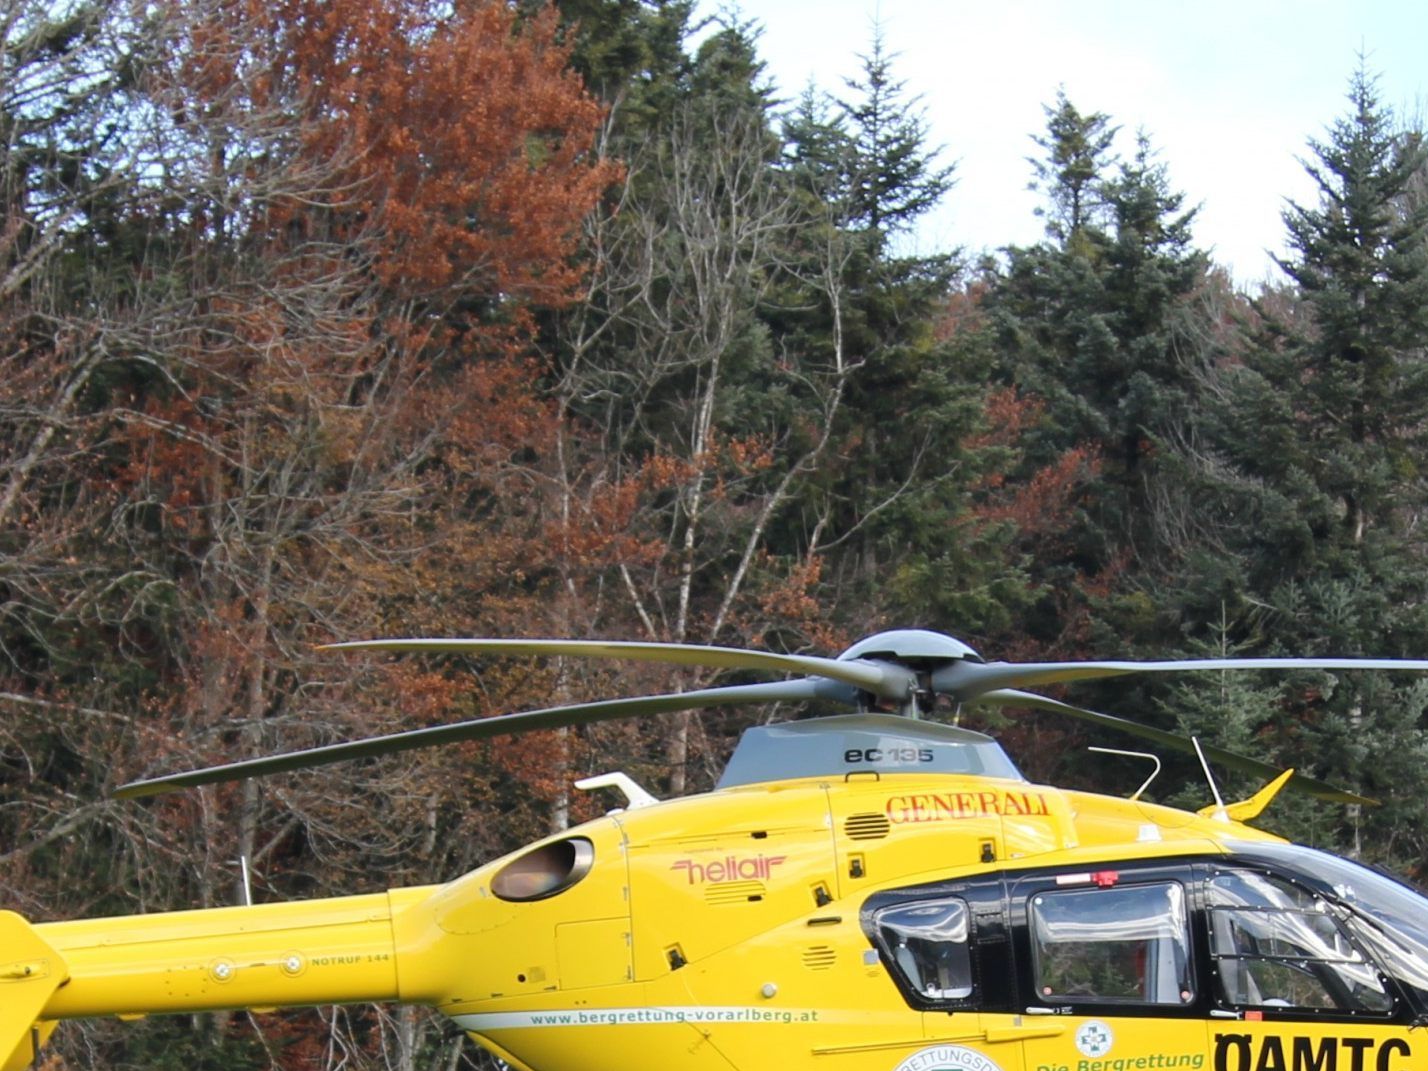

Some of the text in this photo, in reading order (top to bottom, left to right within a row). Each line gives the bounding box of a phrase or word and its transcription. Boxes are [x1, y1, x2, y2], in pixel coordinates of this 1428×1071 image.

[886, 792, 1051, 824] GENERALI
[670, 854, 788, 885] heliair
[311, 954, 389, 967] NOTRUF 144
[531, 1009, 819, 1025] www.bergrettung-vorarlberg.at
